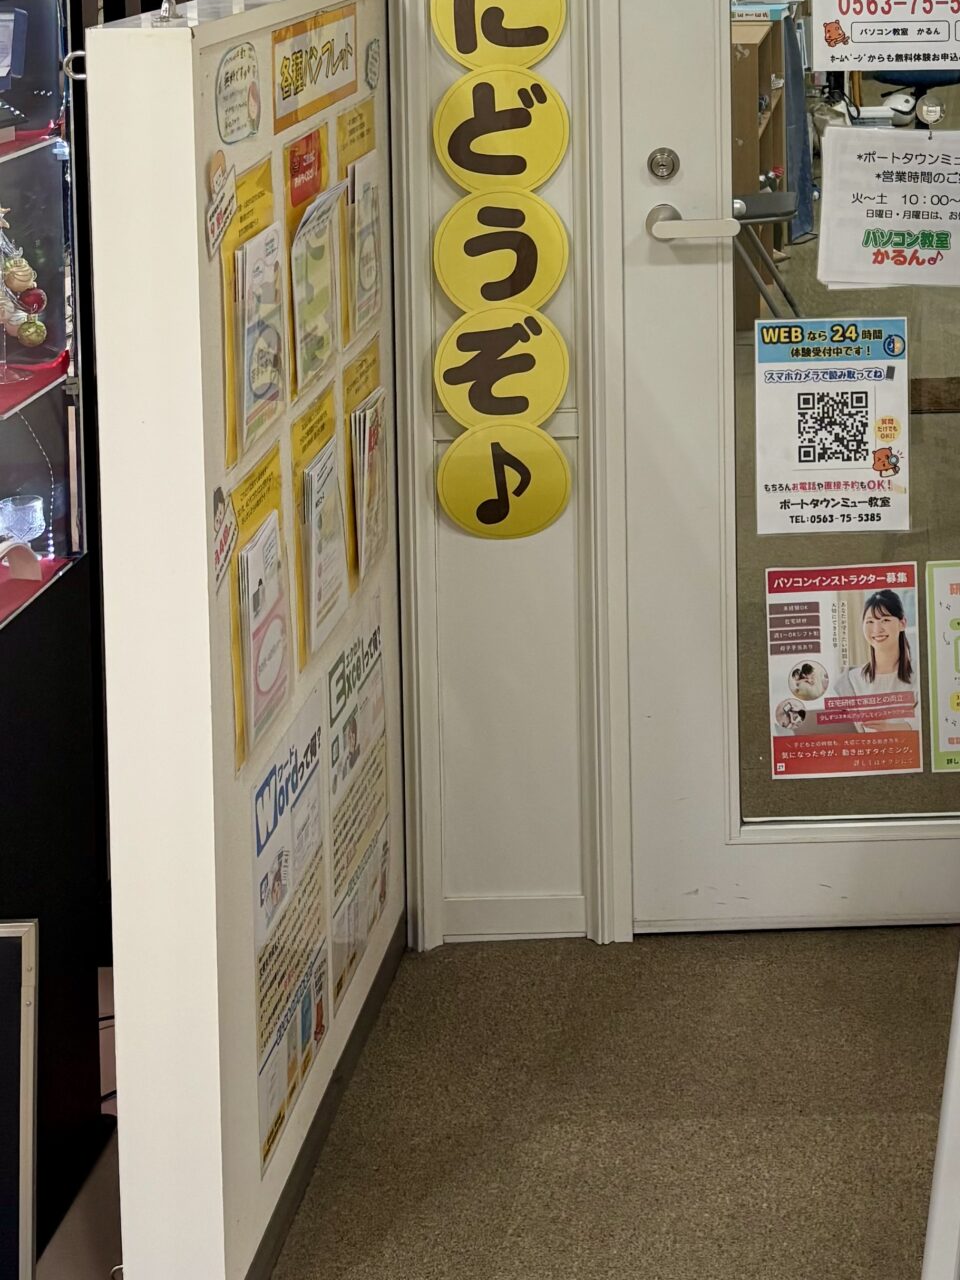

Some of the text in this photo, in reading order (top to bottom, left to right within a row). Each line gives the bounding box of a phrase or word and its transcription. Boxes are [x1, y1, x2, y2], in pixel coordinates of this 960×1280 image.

[859, 27, 909, 37] パソコン教室
[916, 27, 941, 36] かるん
[862, 228, 952, 249] パソコン教室
[764, 368, 884, 383] スマホカメラで読み取ってね
[779, 497, 891, 510] ポートタウンミュー教室
[773, 572, 908, 589] パソコンインストラクター募集
